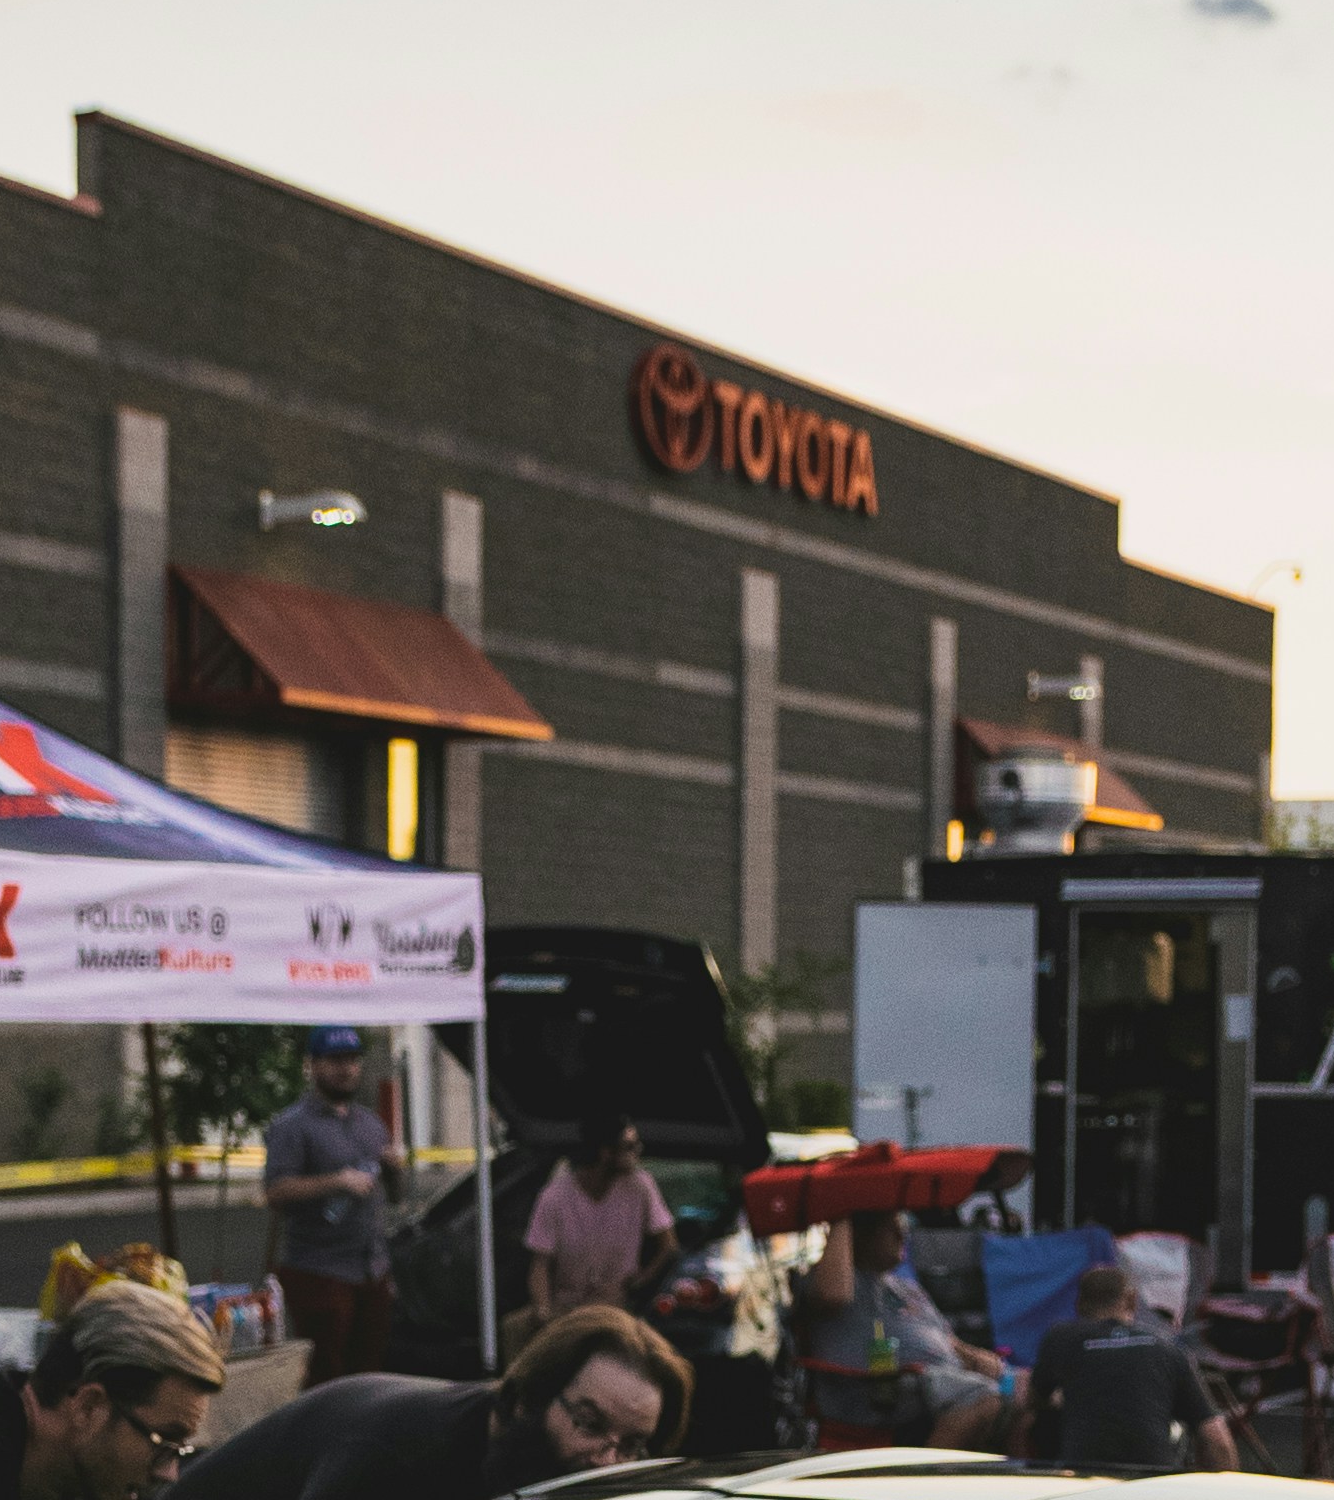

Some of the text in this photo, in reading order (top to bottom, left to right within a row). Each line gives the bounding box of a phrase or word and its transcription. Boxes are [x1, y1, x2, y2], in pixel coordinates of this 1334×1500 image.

[712, 380, 880, 517] TOYOTA
[75, 900, 228, 940] FOLLOW US @
